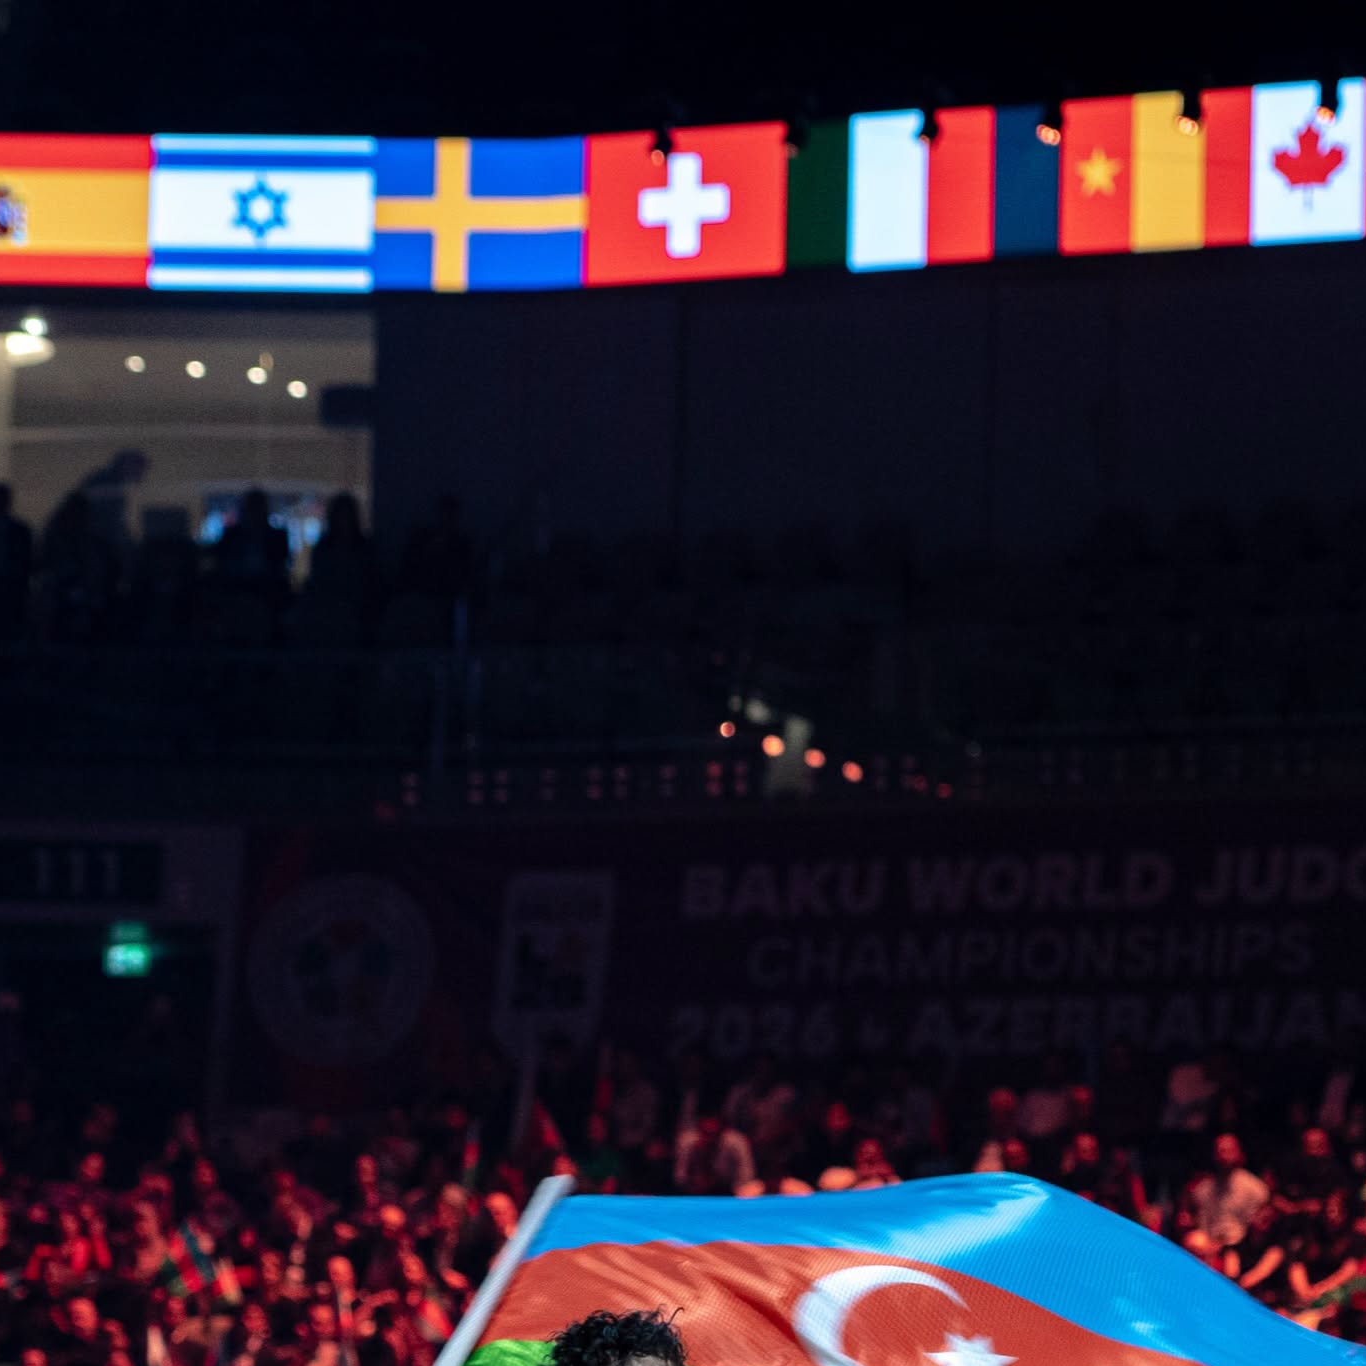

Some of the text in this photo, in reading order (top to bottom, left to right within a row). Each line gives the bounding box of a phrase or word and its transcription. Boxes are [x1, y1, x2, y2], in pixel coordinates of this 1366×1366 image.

[33, 847, 121, 895] 111
[682, 860, 887, 918] BAKU
[906, 850, 1176, 914] WORLD
[746, 920, 1315, 989] CHAMPIONSHIPS
[666, 1001, 838, 1061] 2026
